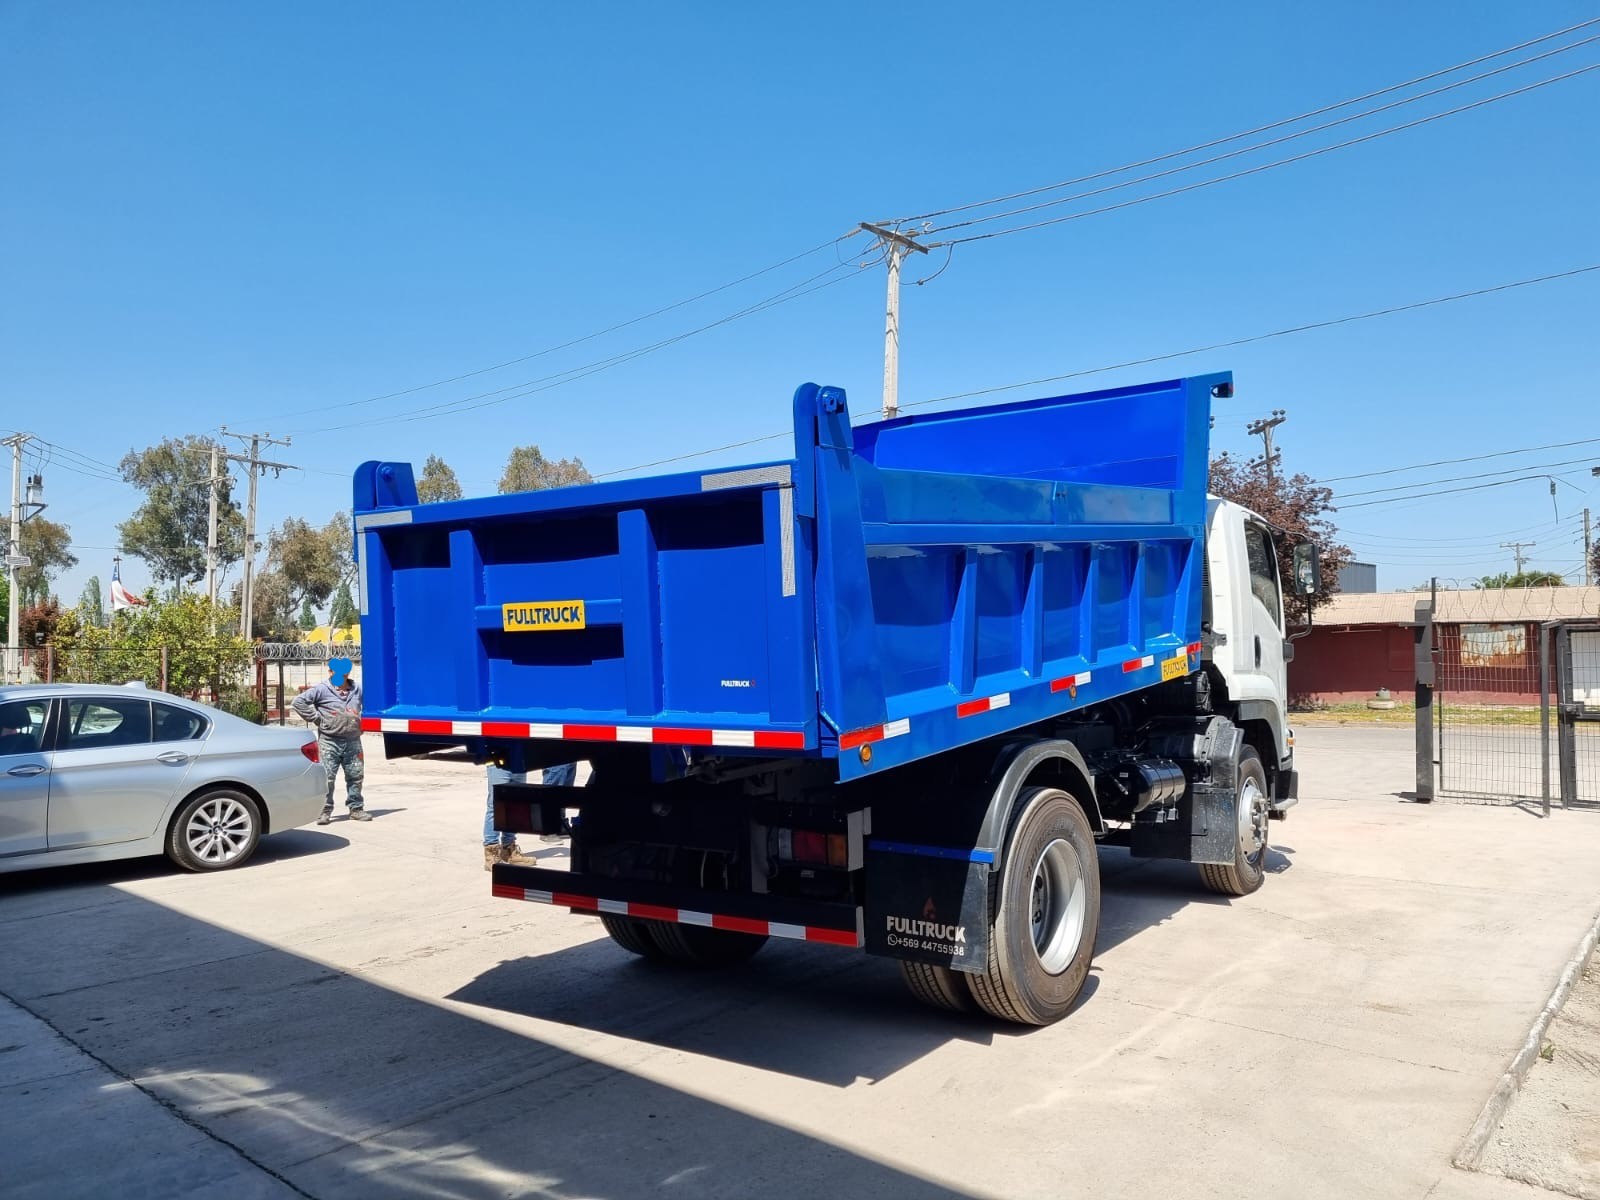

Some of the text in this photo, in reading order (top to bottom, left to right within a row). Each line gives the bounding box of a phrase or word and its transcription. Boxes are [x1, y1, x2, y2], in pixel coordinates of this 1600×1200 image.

[507, 606, 580, 625] FULLTRUCK
[720, 680, 750, 688] FULLTRUCK
[886, 915, 966, 943] FULLTRUCK
[897, 938, 965, 956] +569 44755938
